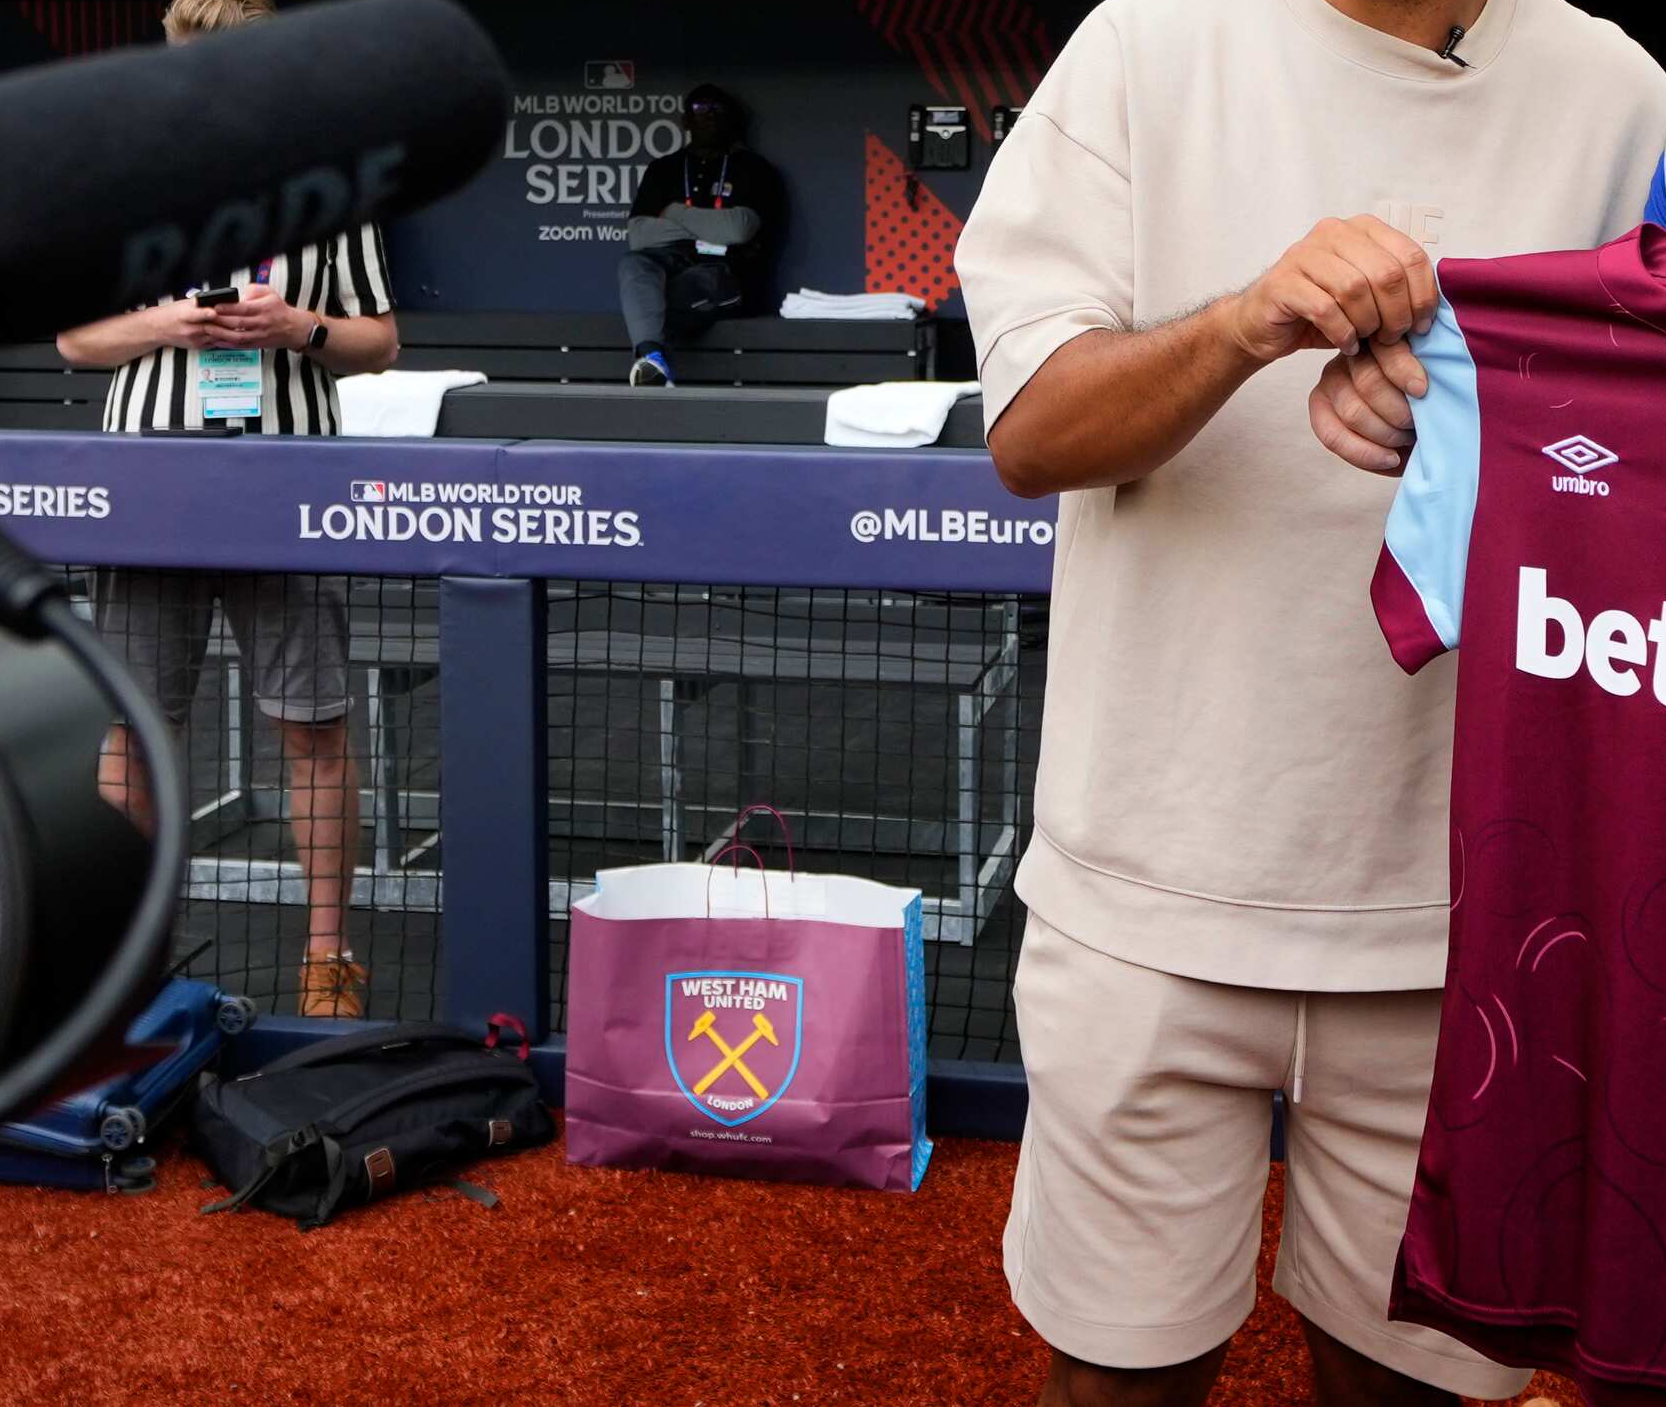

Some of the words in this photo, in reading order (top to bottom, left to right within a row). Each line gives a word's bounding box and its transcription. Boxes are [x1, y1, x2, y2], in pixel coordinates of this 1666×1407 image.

[514, 96, 560, 114] MLB
[563, 96, 644, 114] WORLD
[503, 119, 691, 159] LONDO
[539, 226, 593, 241] zoom
[389, 483, 436, 503] MLB
[438, 483, 521, 504] WORLD
[521, 485, 582, 506] TOUR
[1551, 474, 1610, 497] umbro
[298, 504, 482, 542] LONDON
[491, 507, 640, 547] SERIES
[850, 508, 1059, 545] @MLBEuro
[682, 979, 735, 996] WEST
[739, 980, 788, 1001] HAM
[703, 996, 765, 1010] UNITED
[706, 1095, 753, 1111] LONDON
[690, 1130, 773, 1144] shop.whufc.com
